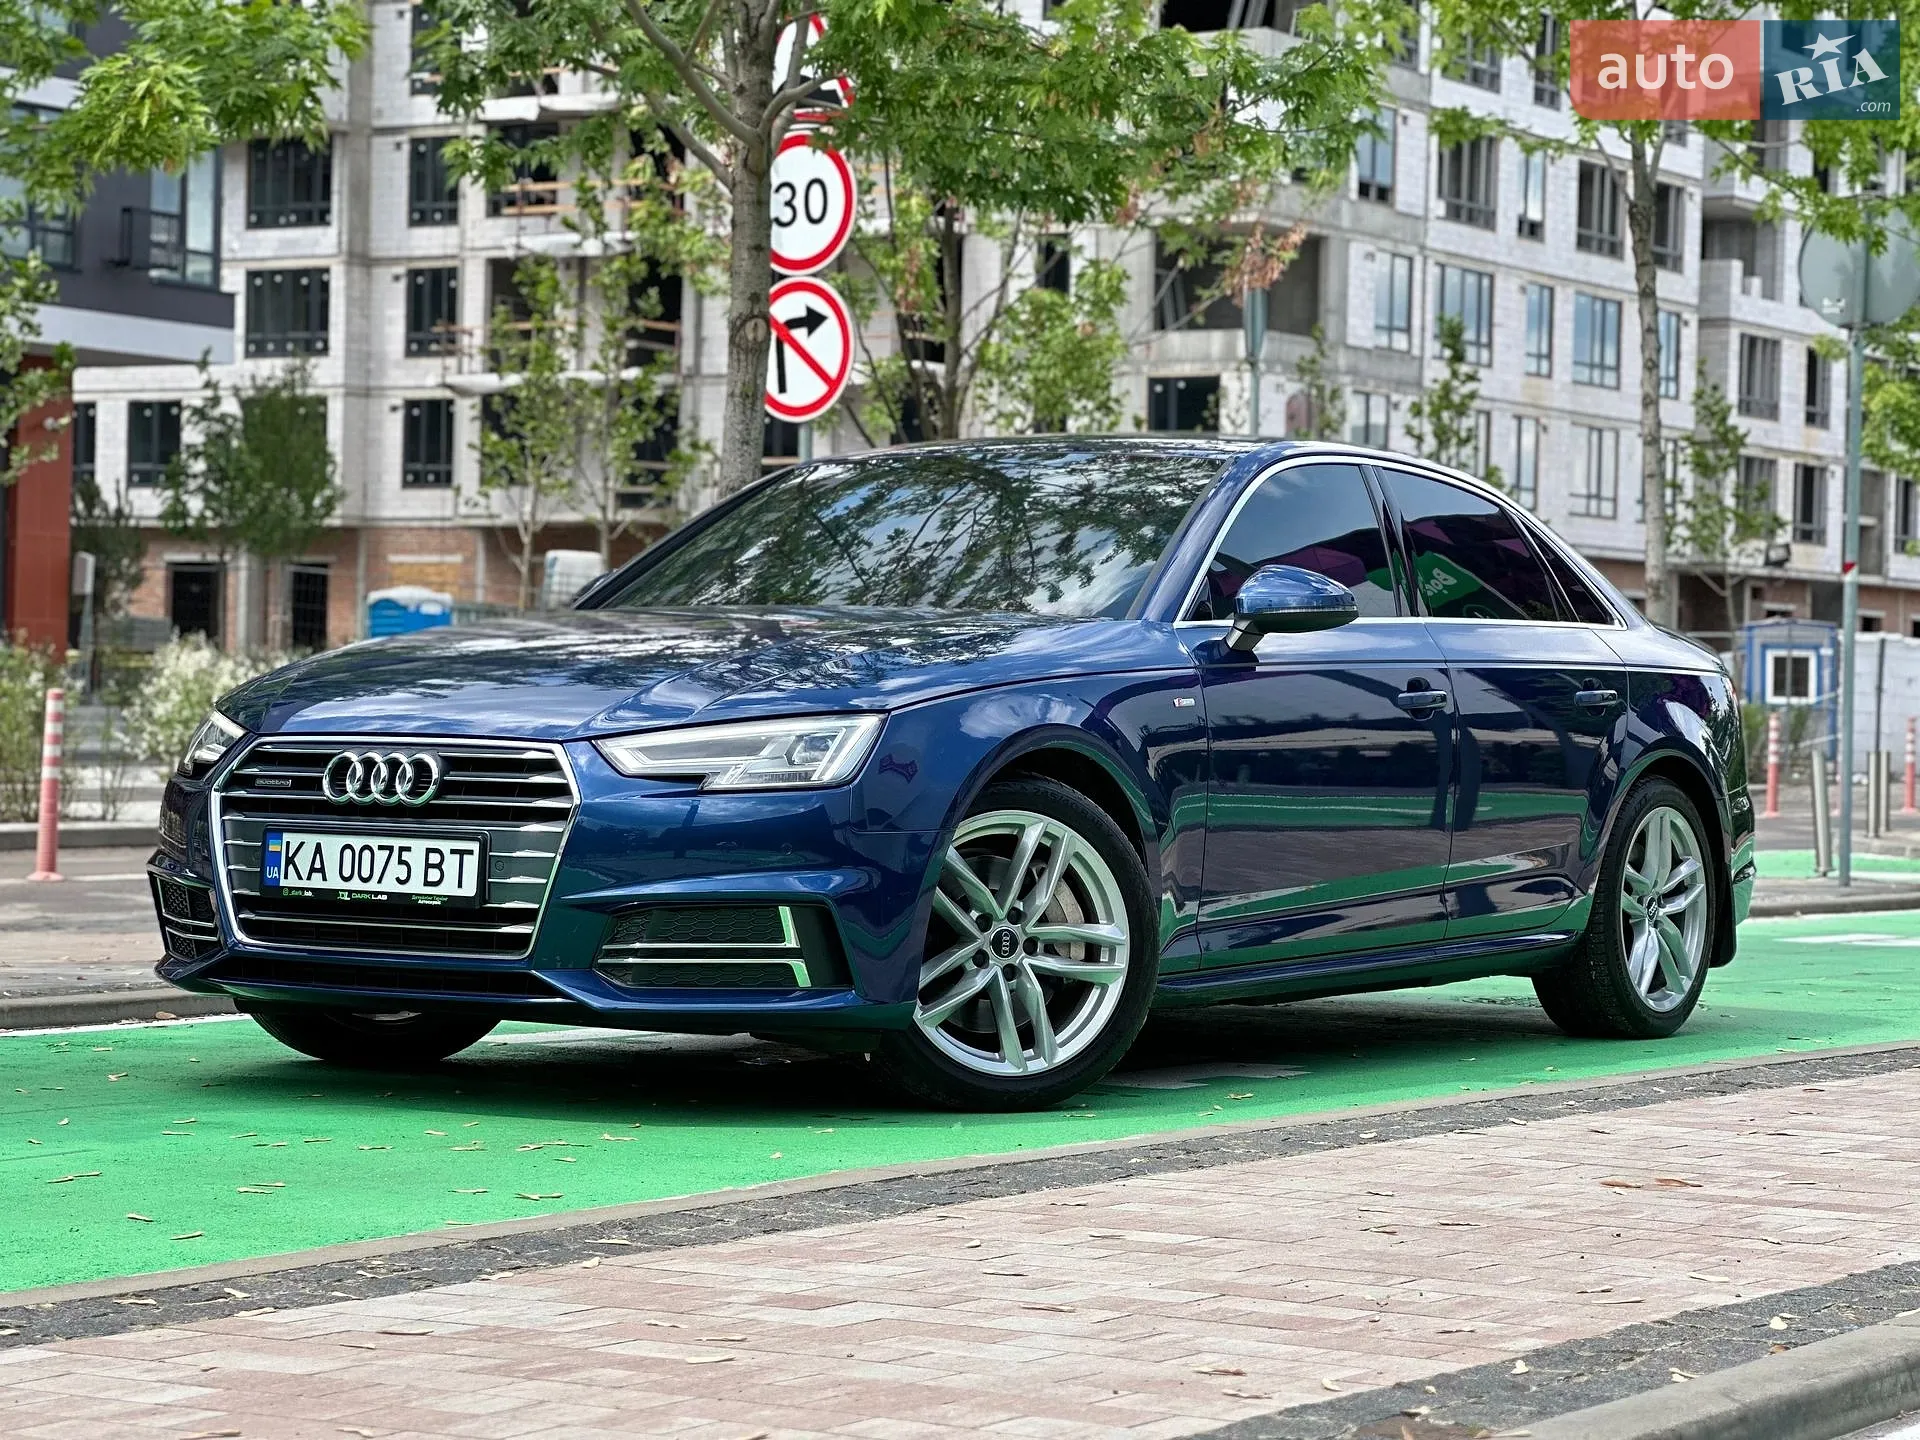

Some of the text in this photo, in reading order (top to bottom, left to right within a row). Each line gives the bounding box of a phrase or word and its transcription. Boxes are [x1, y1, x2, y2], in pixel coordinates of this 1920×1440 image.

[773, 178, 828, 228] 30
[266, 866, 279, 879] UA
[283, 841, 474, 889] KA 0075 BT
